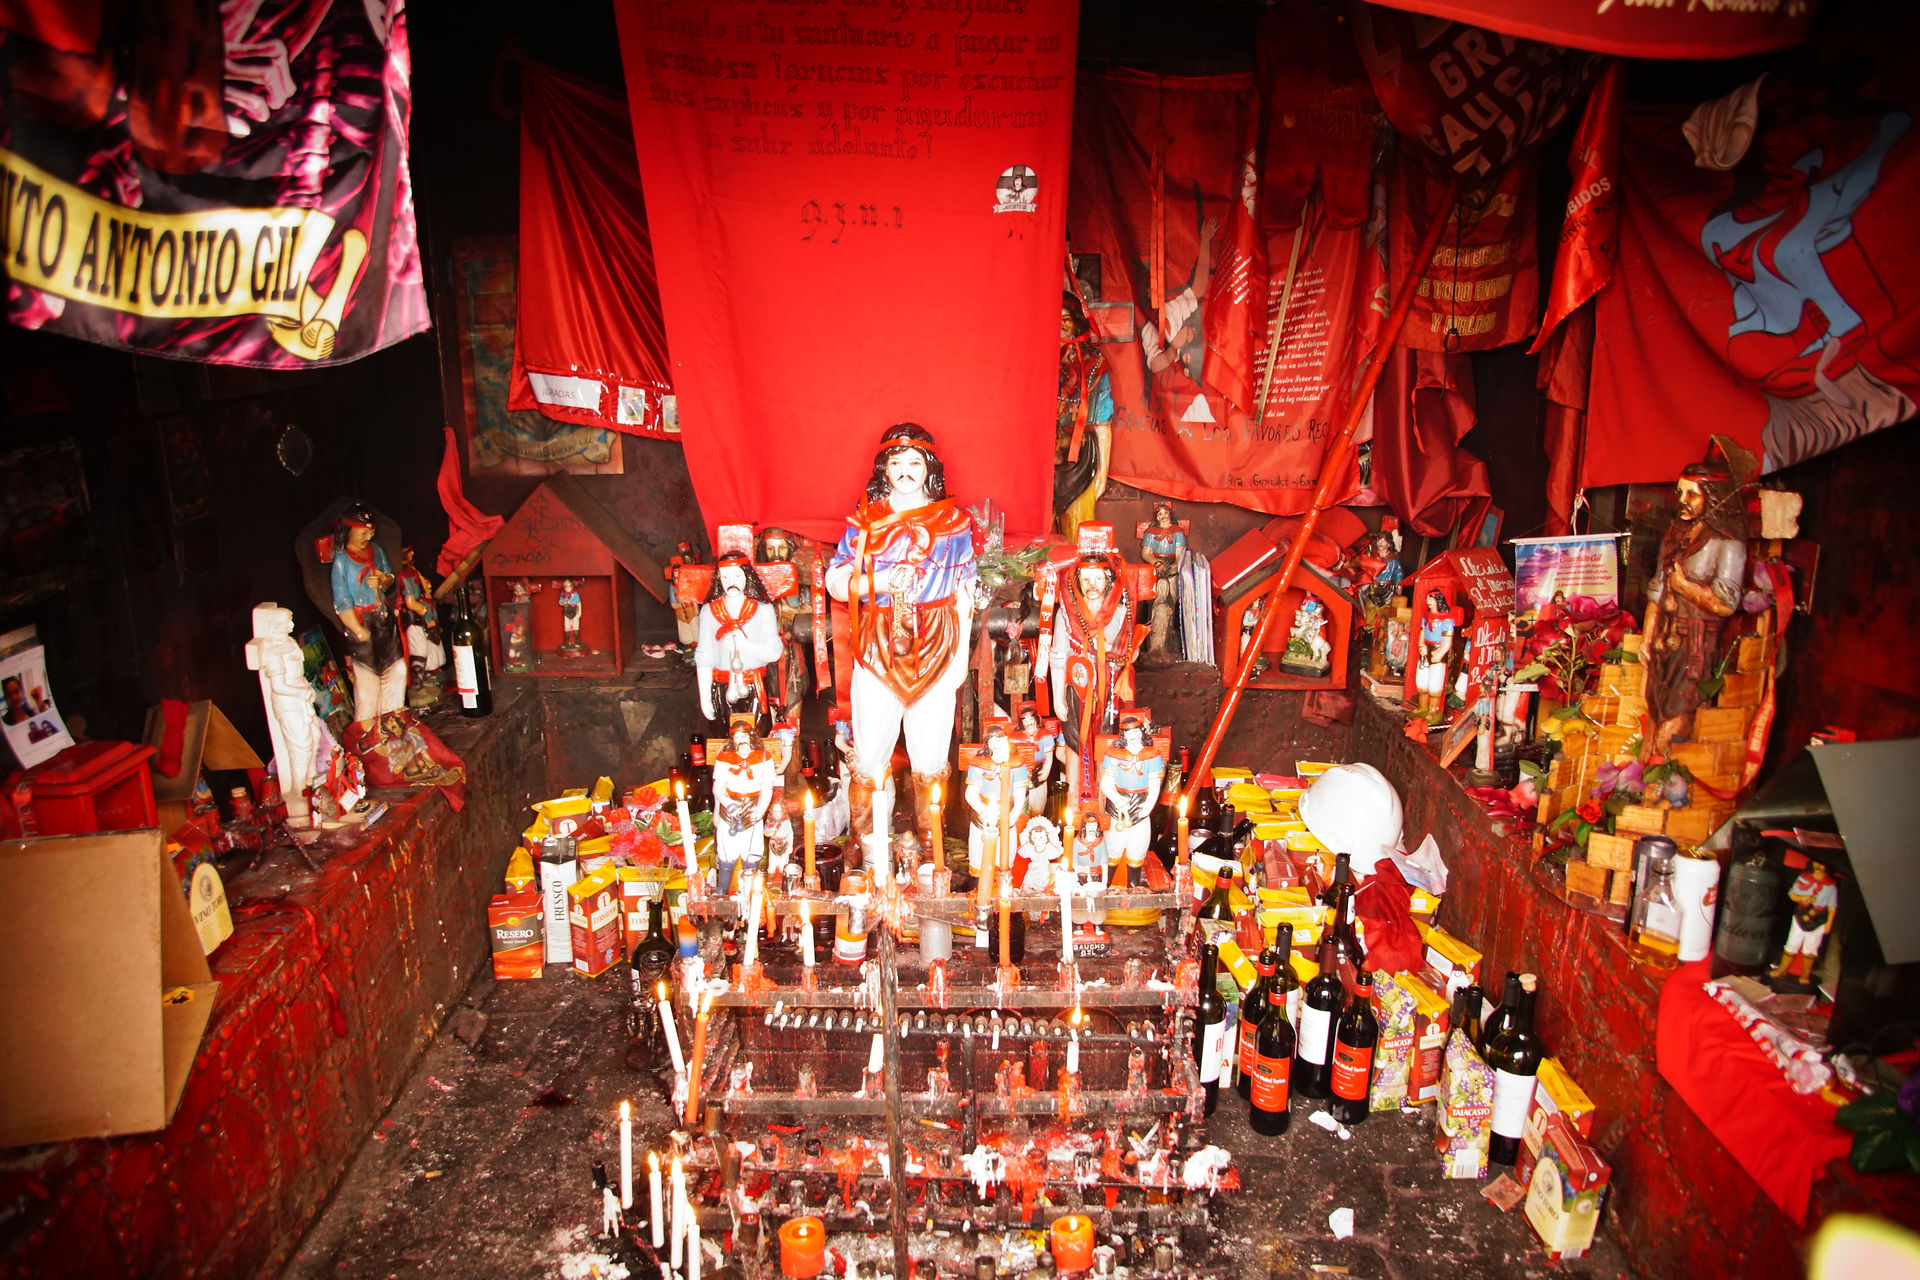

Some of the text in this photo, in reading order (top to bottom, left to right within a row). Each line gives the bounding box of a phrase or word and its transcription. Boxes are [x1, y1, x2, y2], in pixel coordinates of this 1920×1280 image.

[73, 211, 241, 307] ANTONIO
[250, 224, 301, 302] GIL
[552, 880, 565, 921] FRESSCO
[496, 928, 534, 940] RESERO
[1073, 943, 1105, 951] GAUCHO
[1452, 1108, 1490, 1117] TALACASTO
